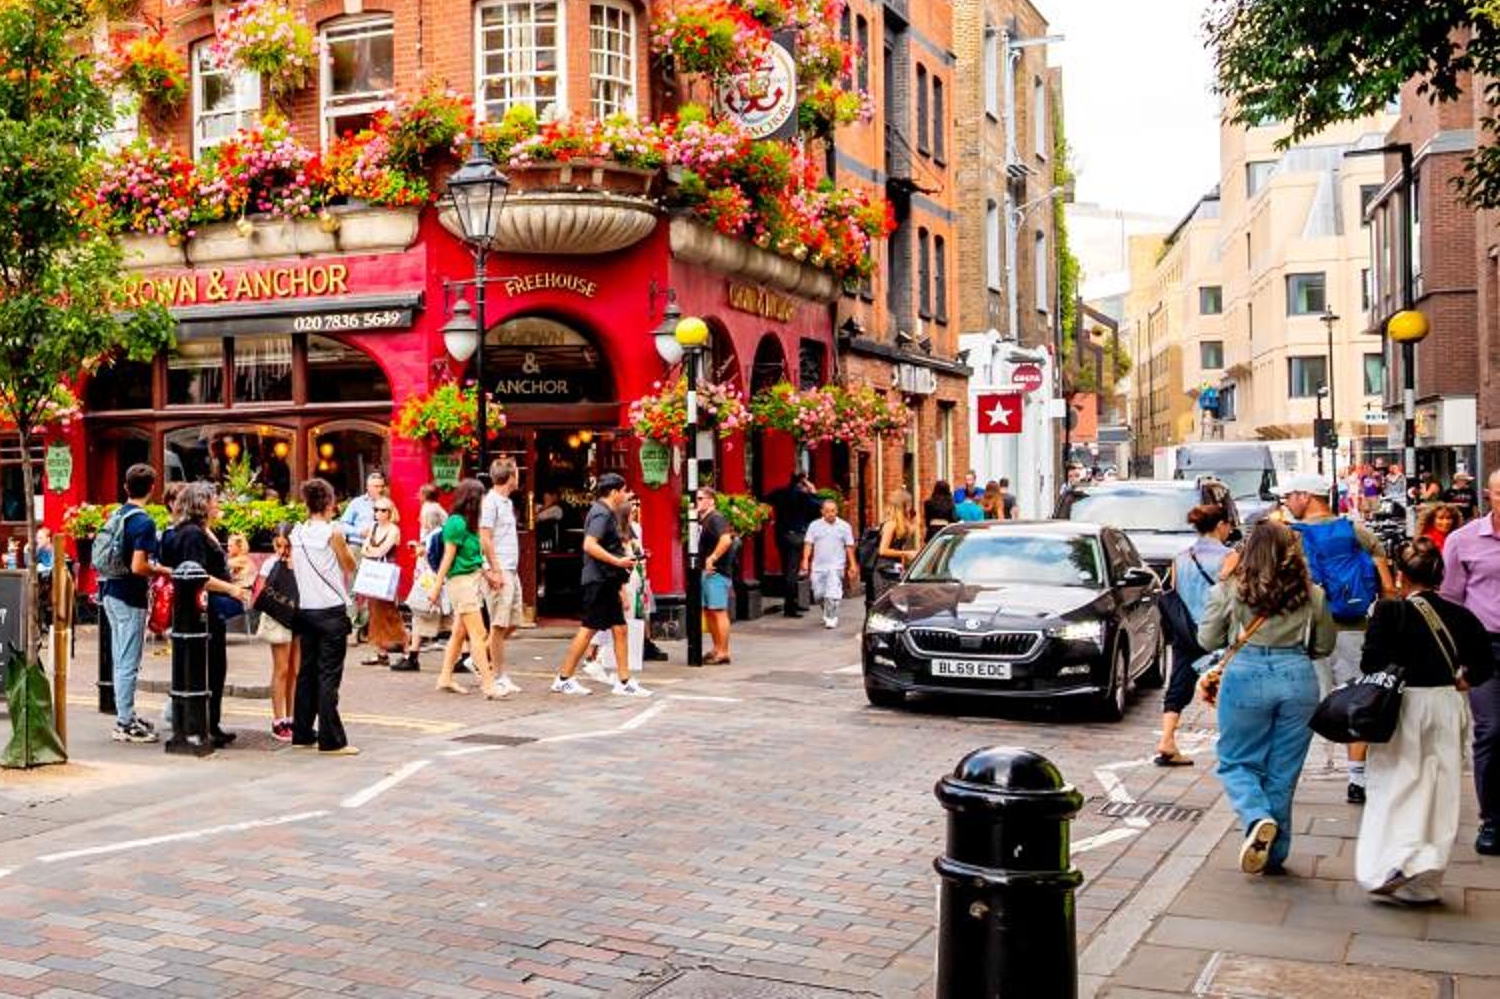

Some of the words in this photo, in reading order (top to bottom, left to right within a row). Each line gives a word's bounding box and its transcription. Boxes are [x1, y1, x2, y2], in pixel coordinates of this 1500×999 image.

[107, 276, 198, 307] ROWN
[206, 268, 229, 300] &
[234, 264, 348, 300] ANCHOR
[505, 272, 597, 298] FREEHOUSE
[294, 316, 322, 331] 020
[324, 314, 360, 329] 7836
[363, 311, 401, 327] 5649
[522, 352, 541, 374] &
[495, 380, 569, 394] ANCHOR
